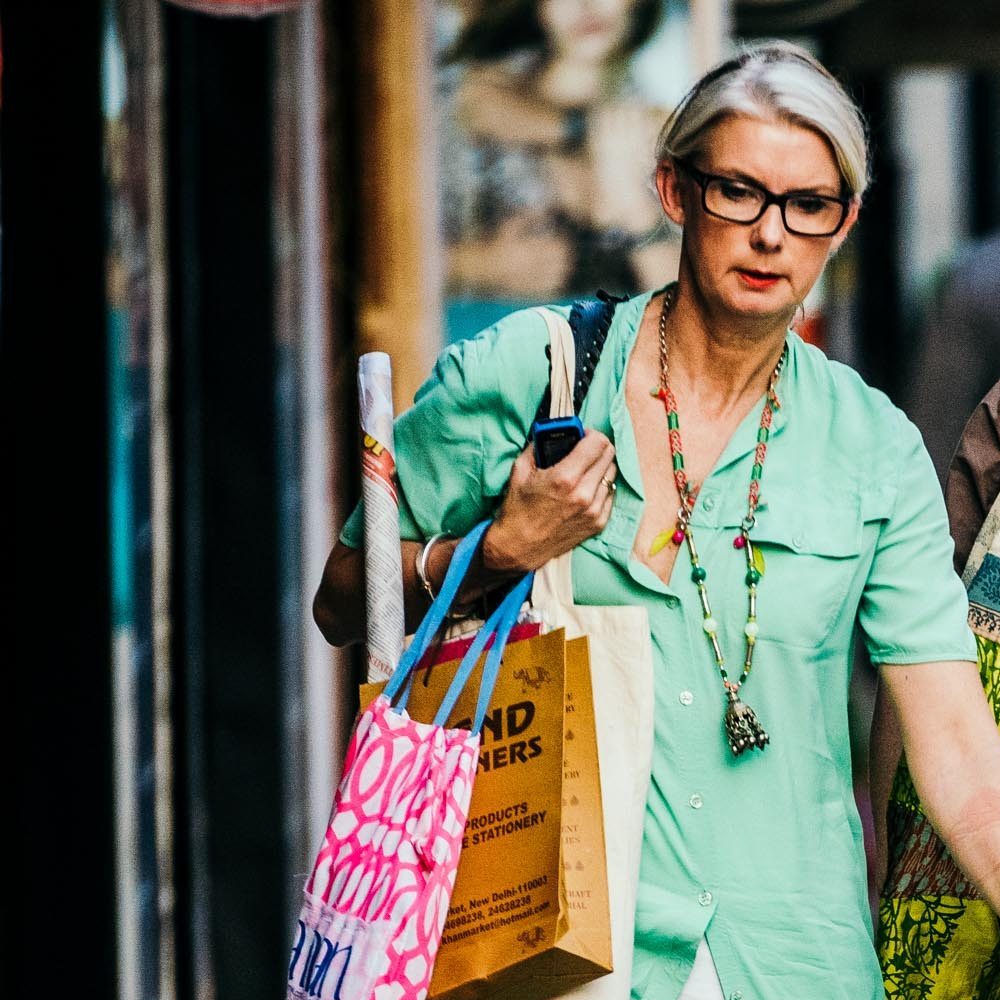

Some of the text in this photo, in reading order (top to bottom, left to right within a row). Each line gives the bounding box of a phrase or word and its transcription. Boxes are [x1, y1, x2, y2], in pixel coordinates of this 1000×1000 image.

[464, 802, 528, 832] PRODUCTS
[472, 810, 547, 845] STATIONERY
[469, 896, 490, 910] New
